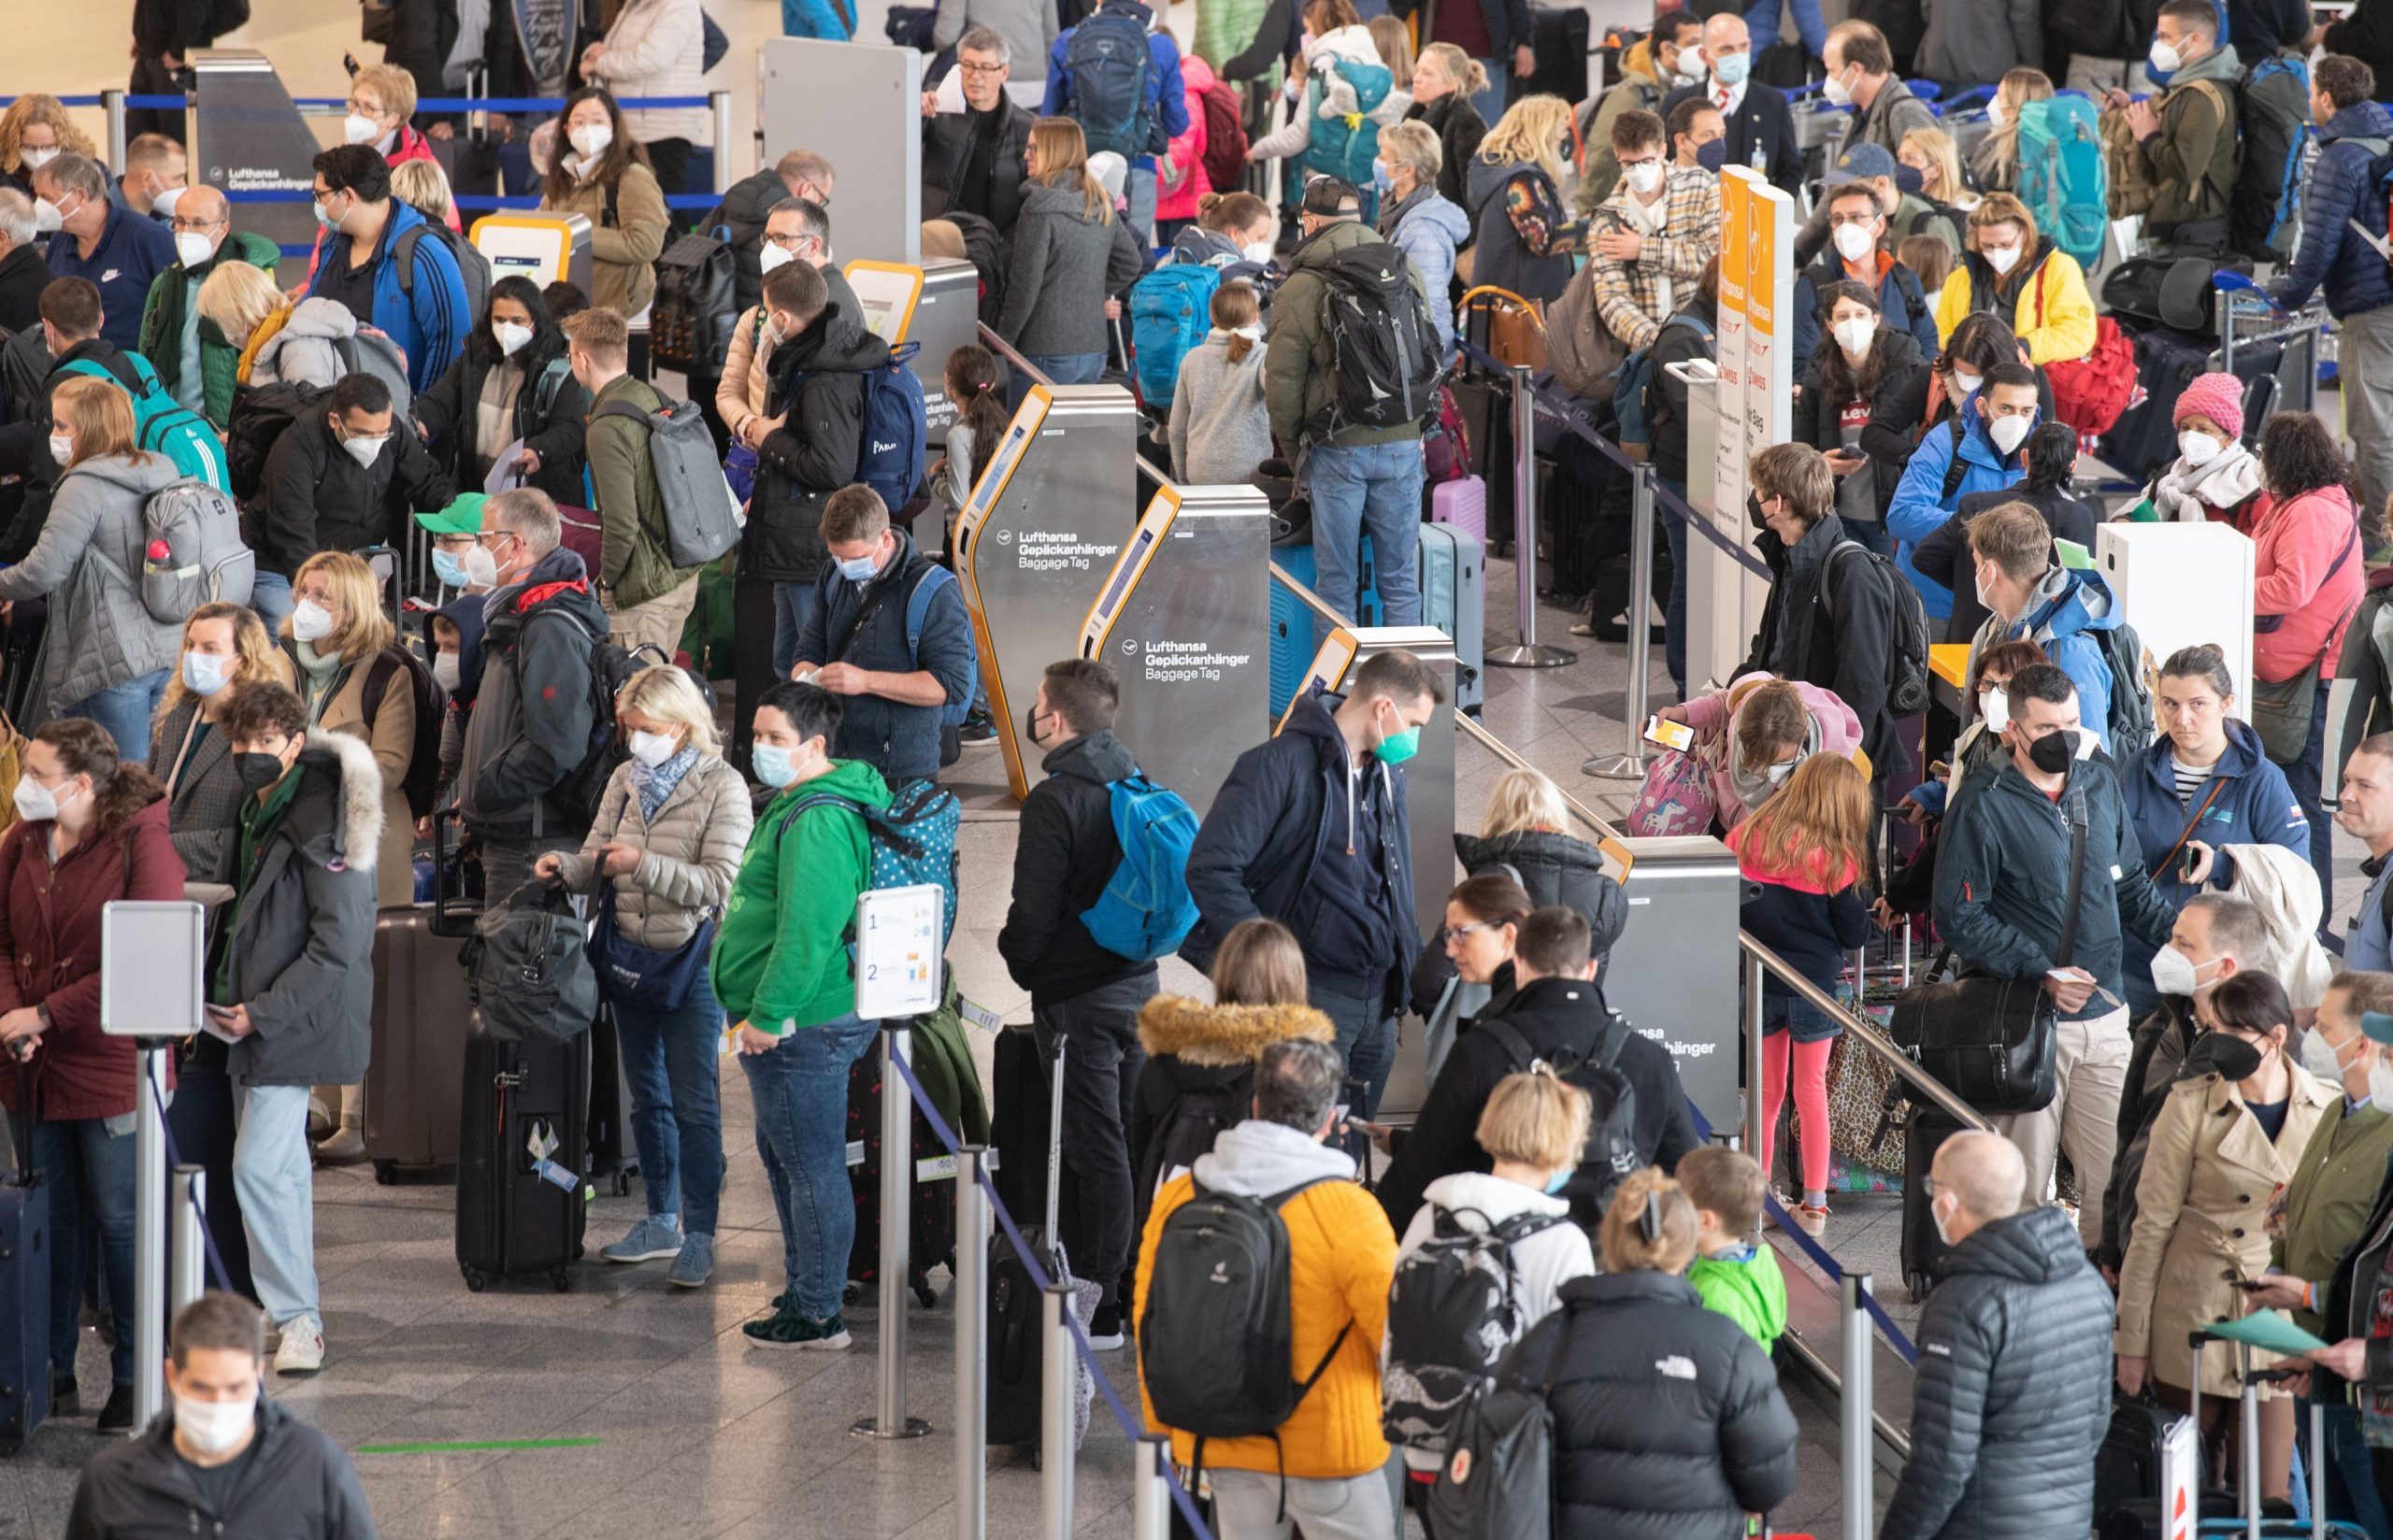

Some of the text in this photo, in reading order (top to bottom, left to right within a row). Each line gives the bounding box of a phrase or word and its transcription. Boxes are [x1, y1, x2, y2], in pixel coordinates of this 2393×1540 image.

[228, 168, 279, 178] Lufthansa
[1841, 407, 1870, 420] Lev
[1019, 532, 1077, 542] Lufthansa
[1019, 544, 1118, 557] Gepäckanhänger
[1019, 556, 1089, 570] Baggage Tag
[1145, 641, 1207, 652] Lufthansa
[1145, 654, 1250, 667] Gepäckanhänger
[1145, 667, 1220, 681] Baggage Tag
[868, 915, 878, 930] 1
[868, 964, 878, 980] 2
